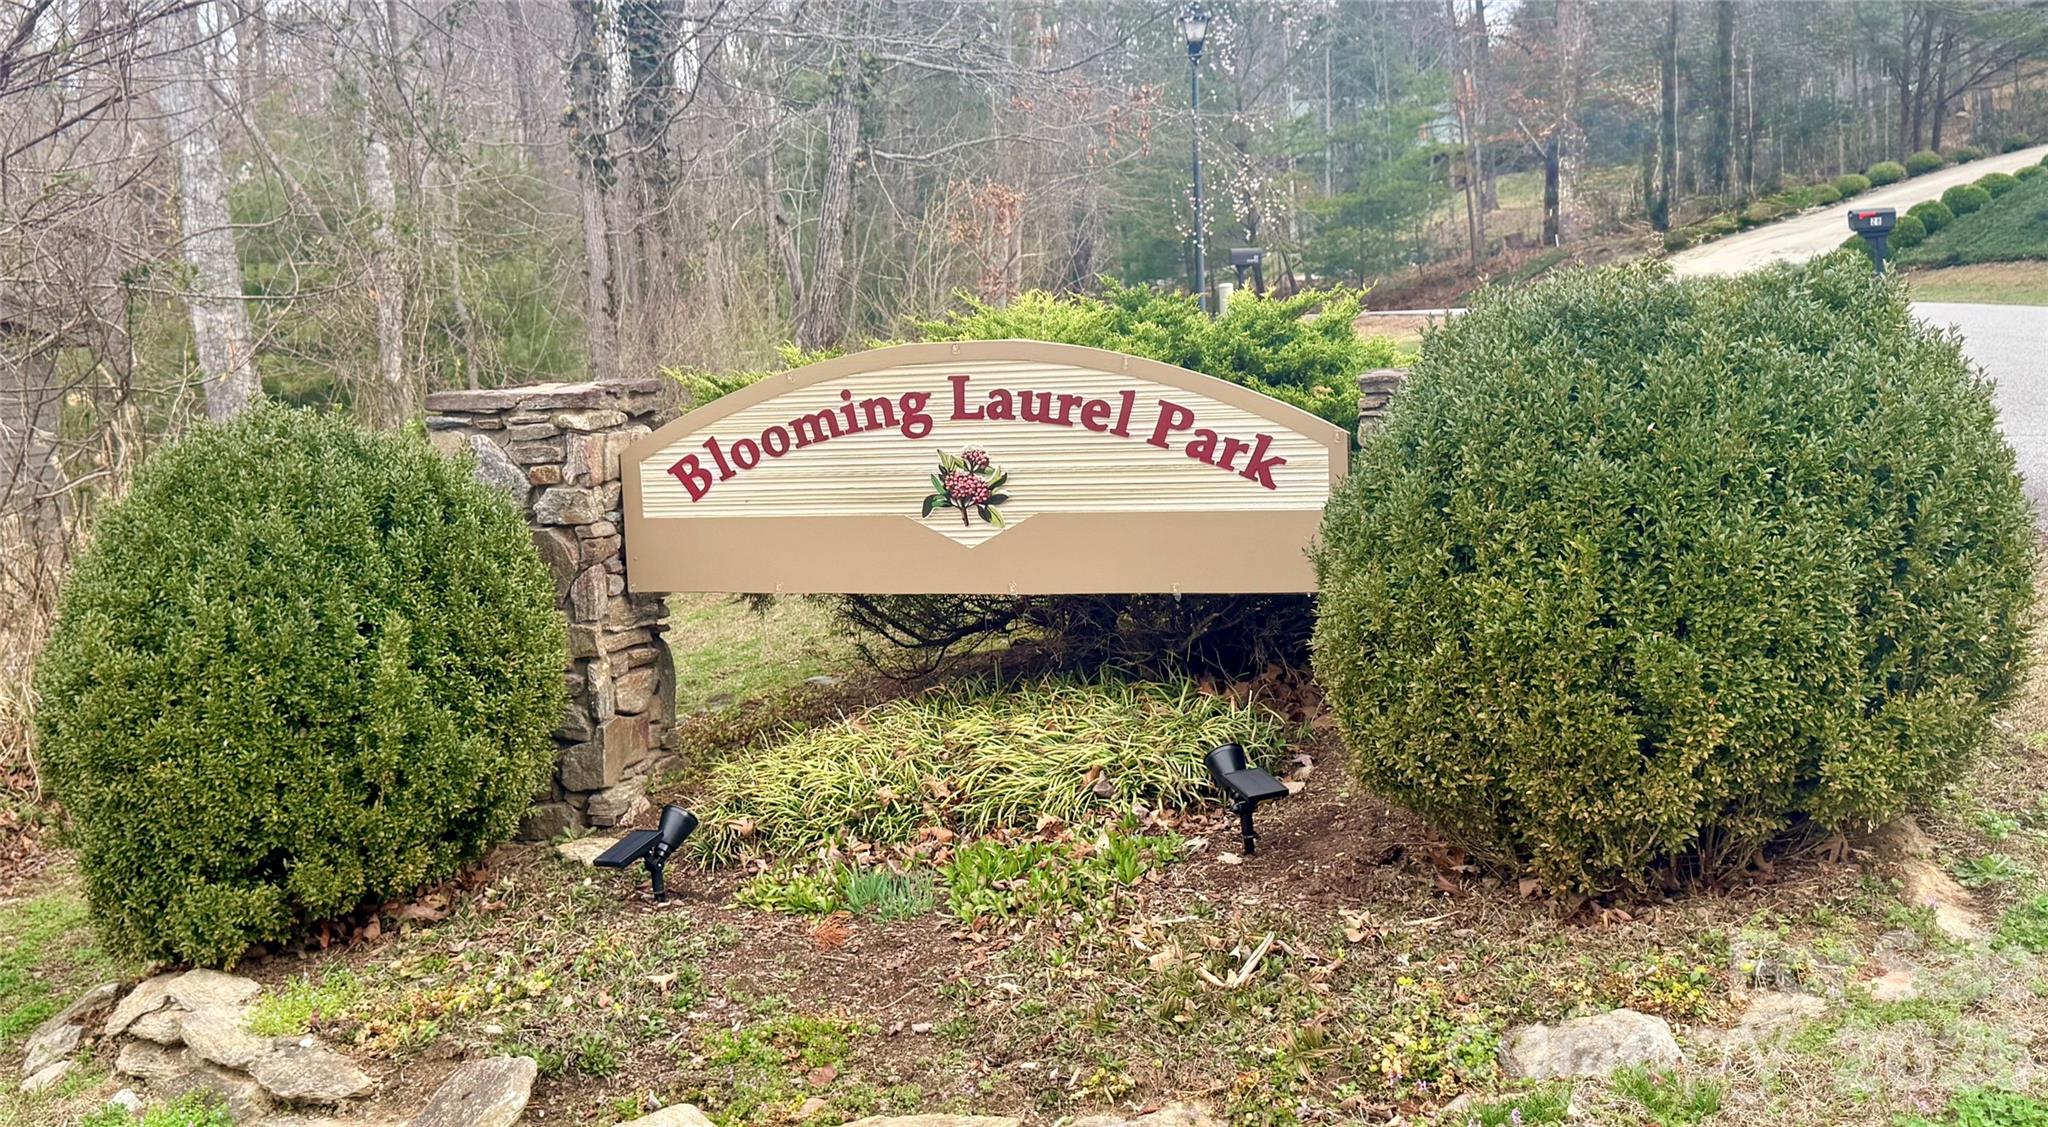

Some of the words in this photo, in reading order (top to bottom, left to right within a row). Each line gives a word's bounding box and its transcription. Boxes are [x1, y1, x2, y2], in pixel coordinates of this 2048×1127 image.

[667, 388, 933, 502] Blooming
[948, 375, 1136, 438] Laurel
[1147, 399, 1287, 490] Park
